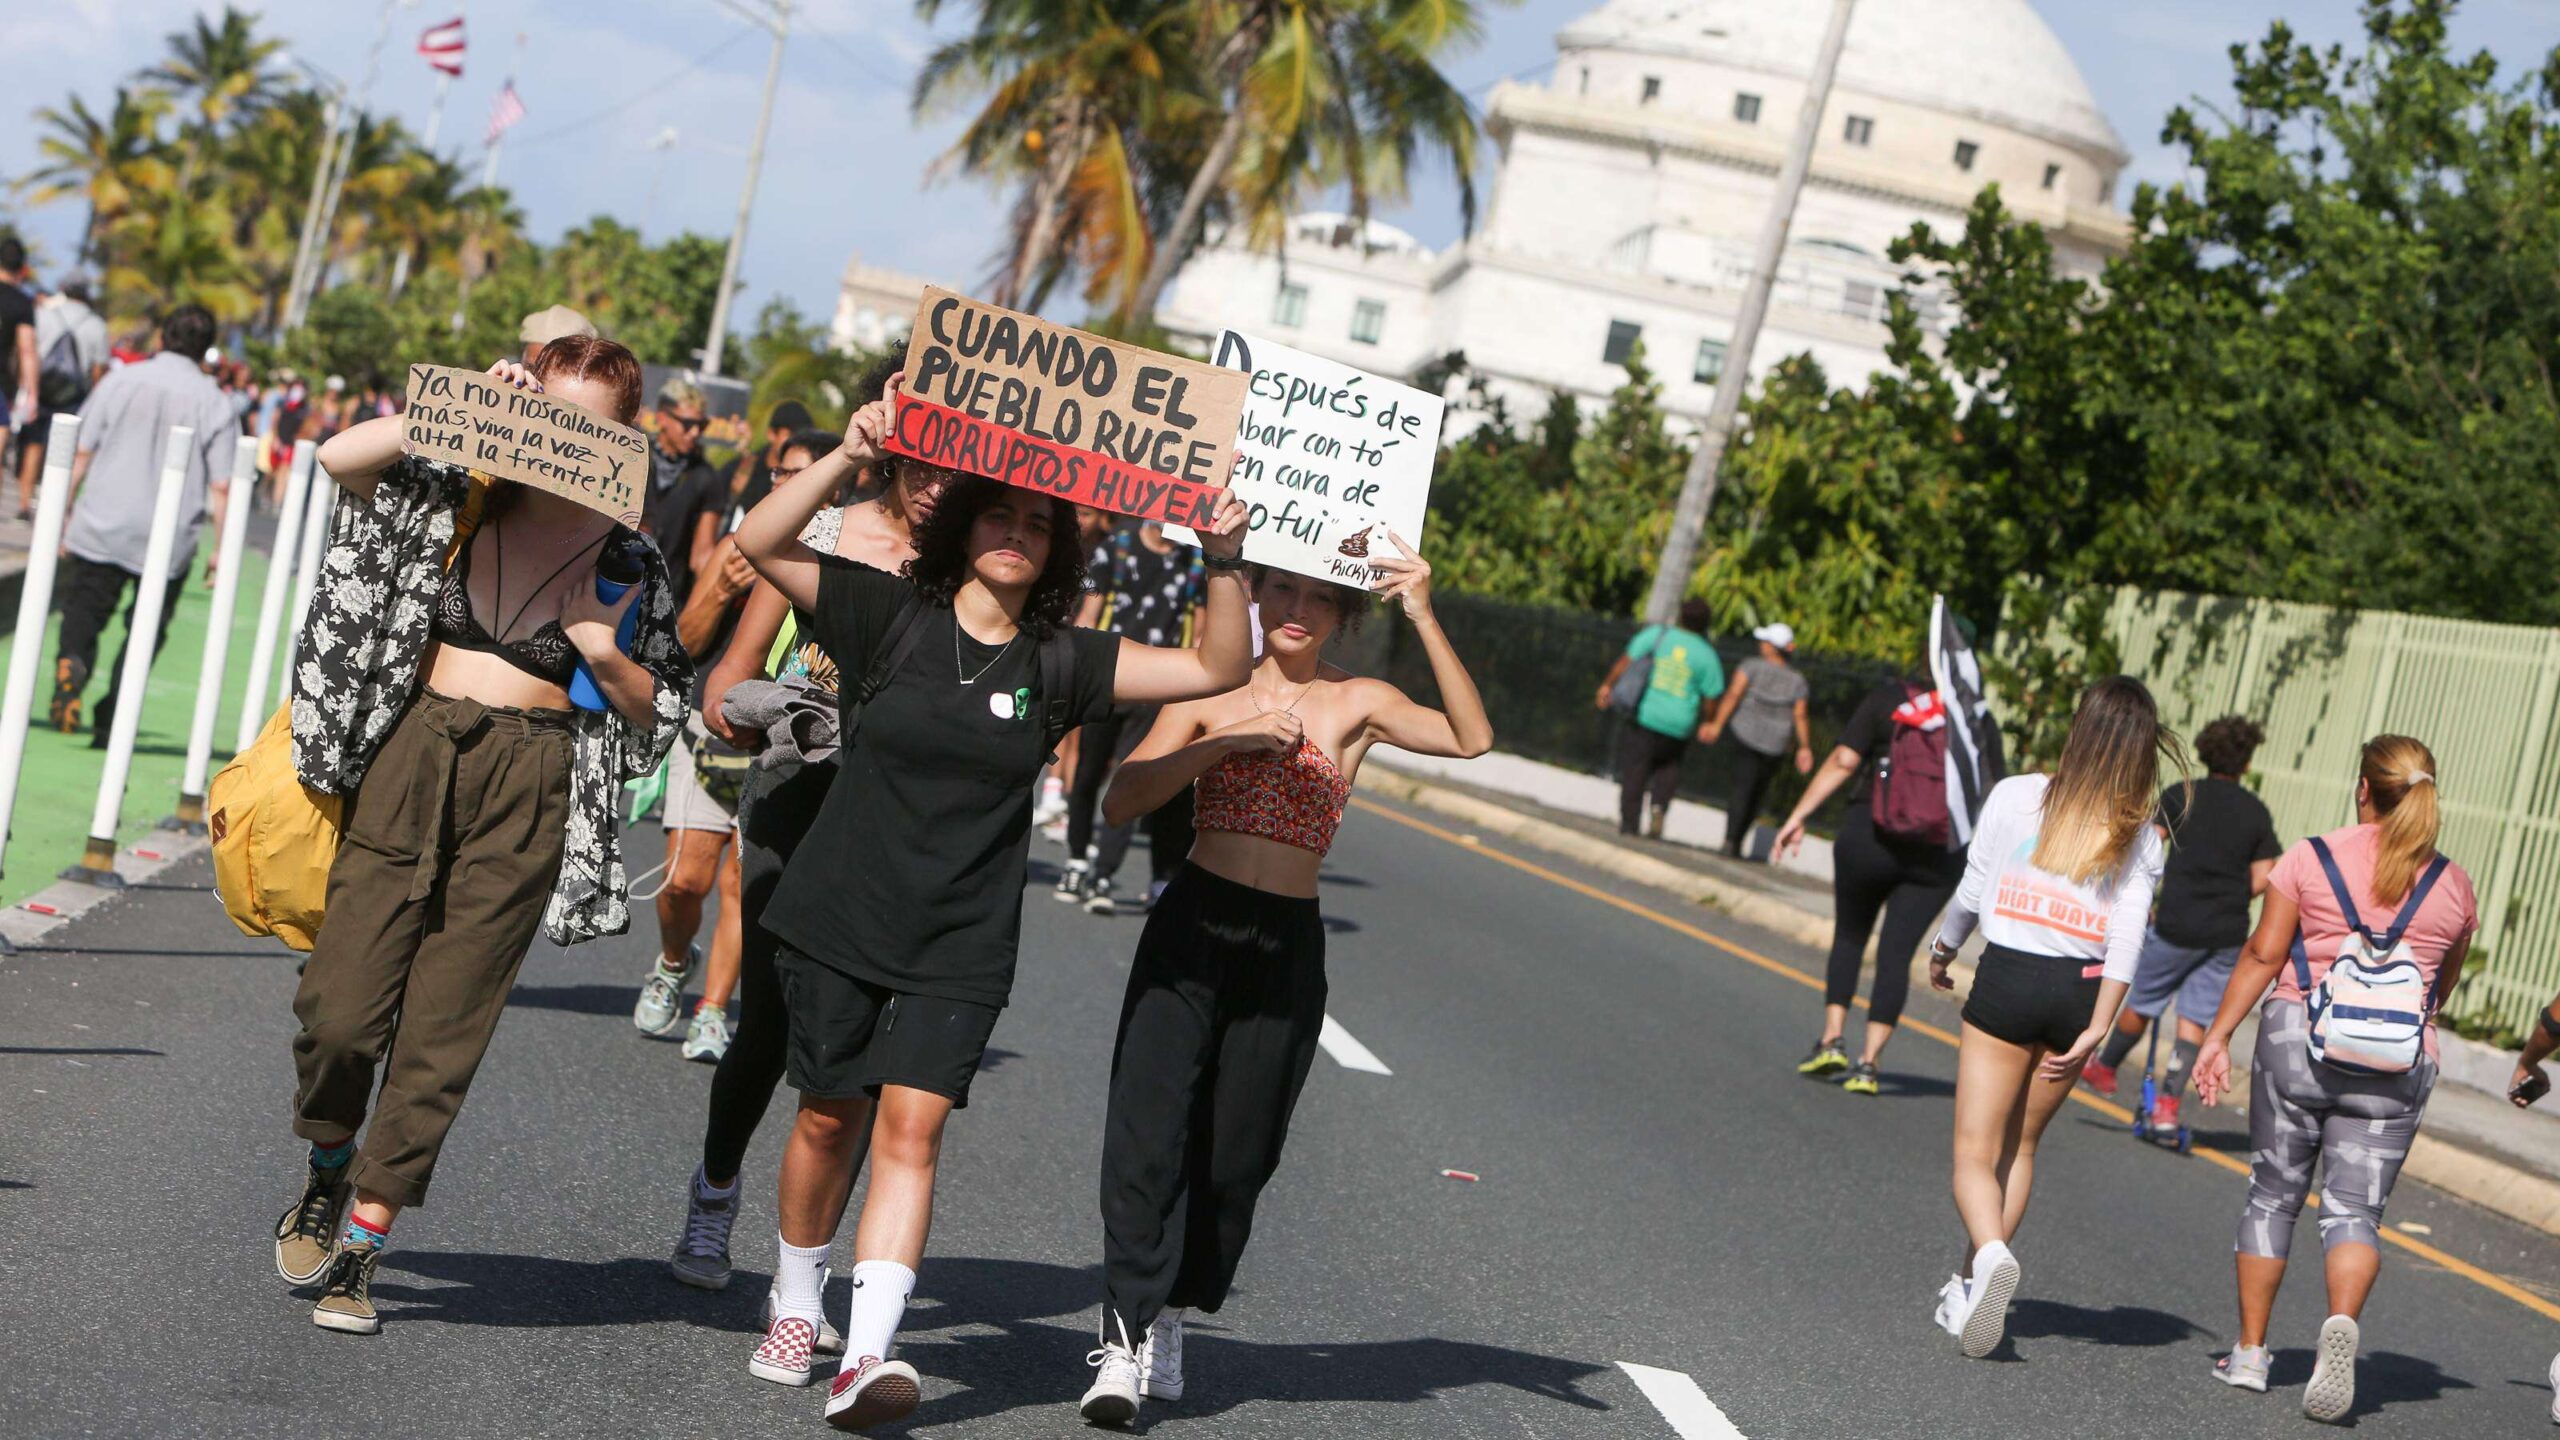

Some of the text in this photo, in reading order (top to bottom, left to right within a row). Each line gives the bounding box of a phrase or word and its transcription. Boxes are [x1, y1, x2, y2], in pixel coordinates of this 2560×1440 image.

[930, 297, 1199, 430] CUANDO EL
[463, 380, 500, 408] no
[912, 345, 1217, 484] PUEBLO RUGE
[473, 416, 514, 441] viva
[521, 429, 544, 448] la
[550, 437, 600, 464] voz
[1376, 400, 1422, 439] de
[409, 425, 464, 452] alta
[476, 438, 499, 464] la
[897, 402, 1219, 528] CORRUPTOS HUYEN
[1303, 432, 1341, 460] con
[1348, 439, 1400, 467] tó
[1275, 464, 1330, 498] cara
[1342, 478, 1380, 507] de
[2047, 899, 2109, 933] WAVE
